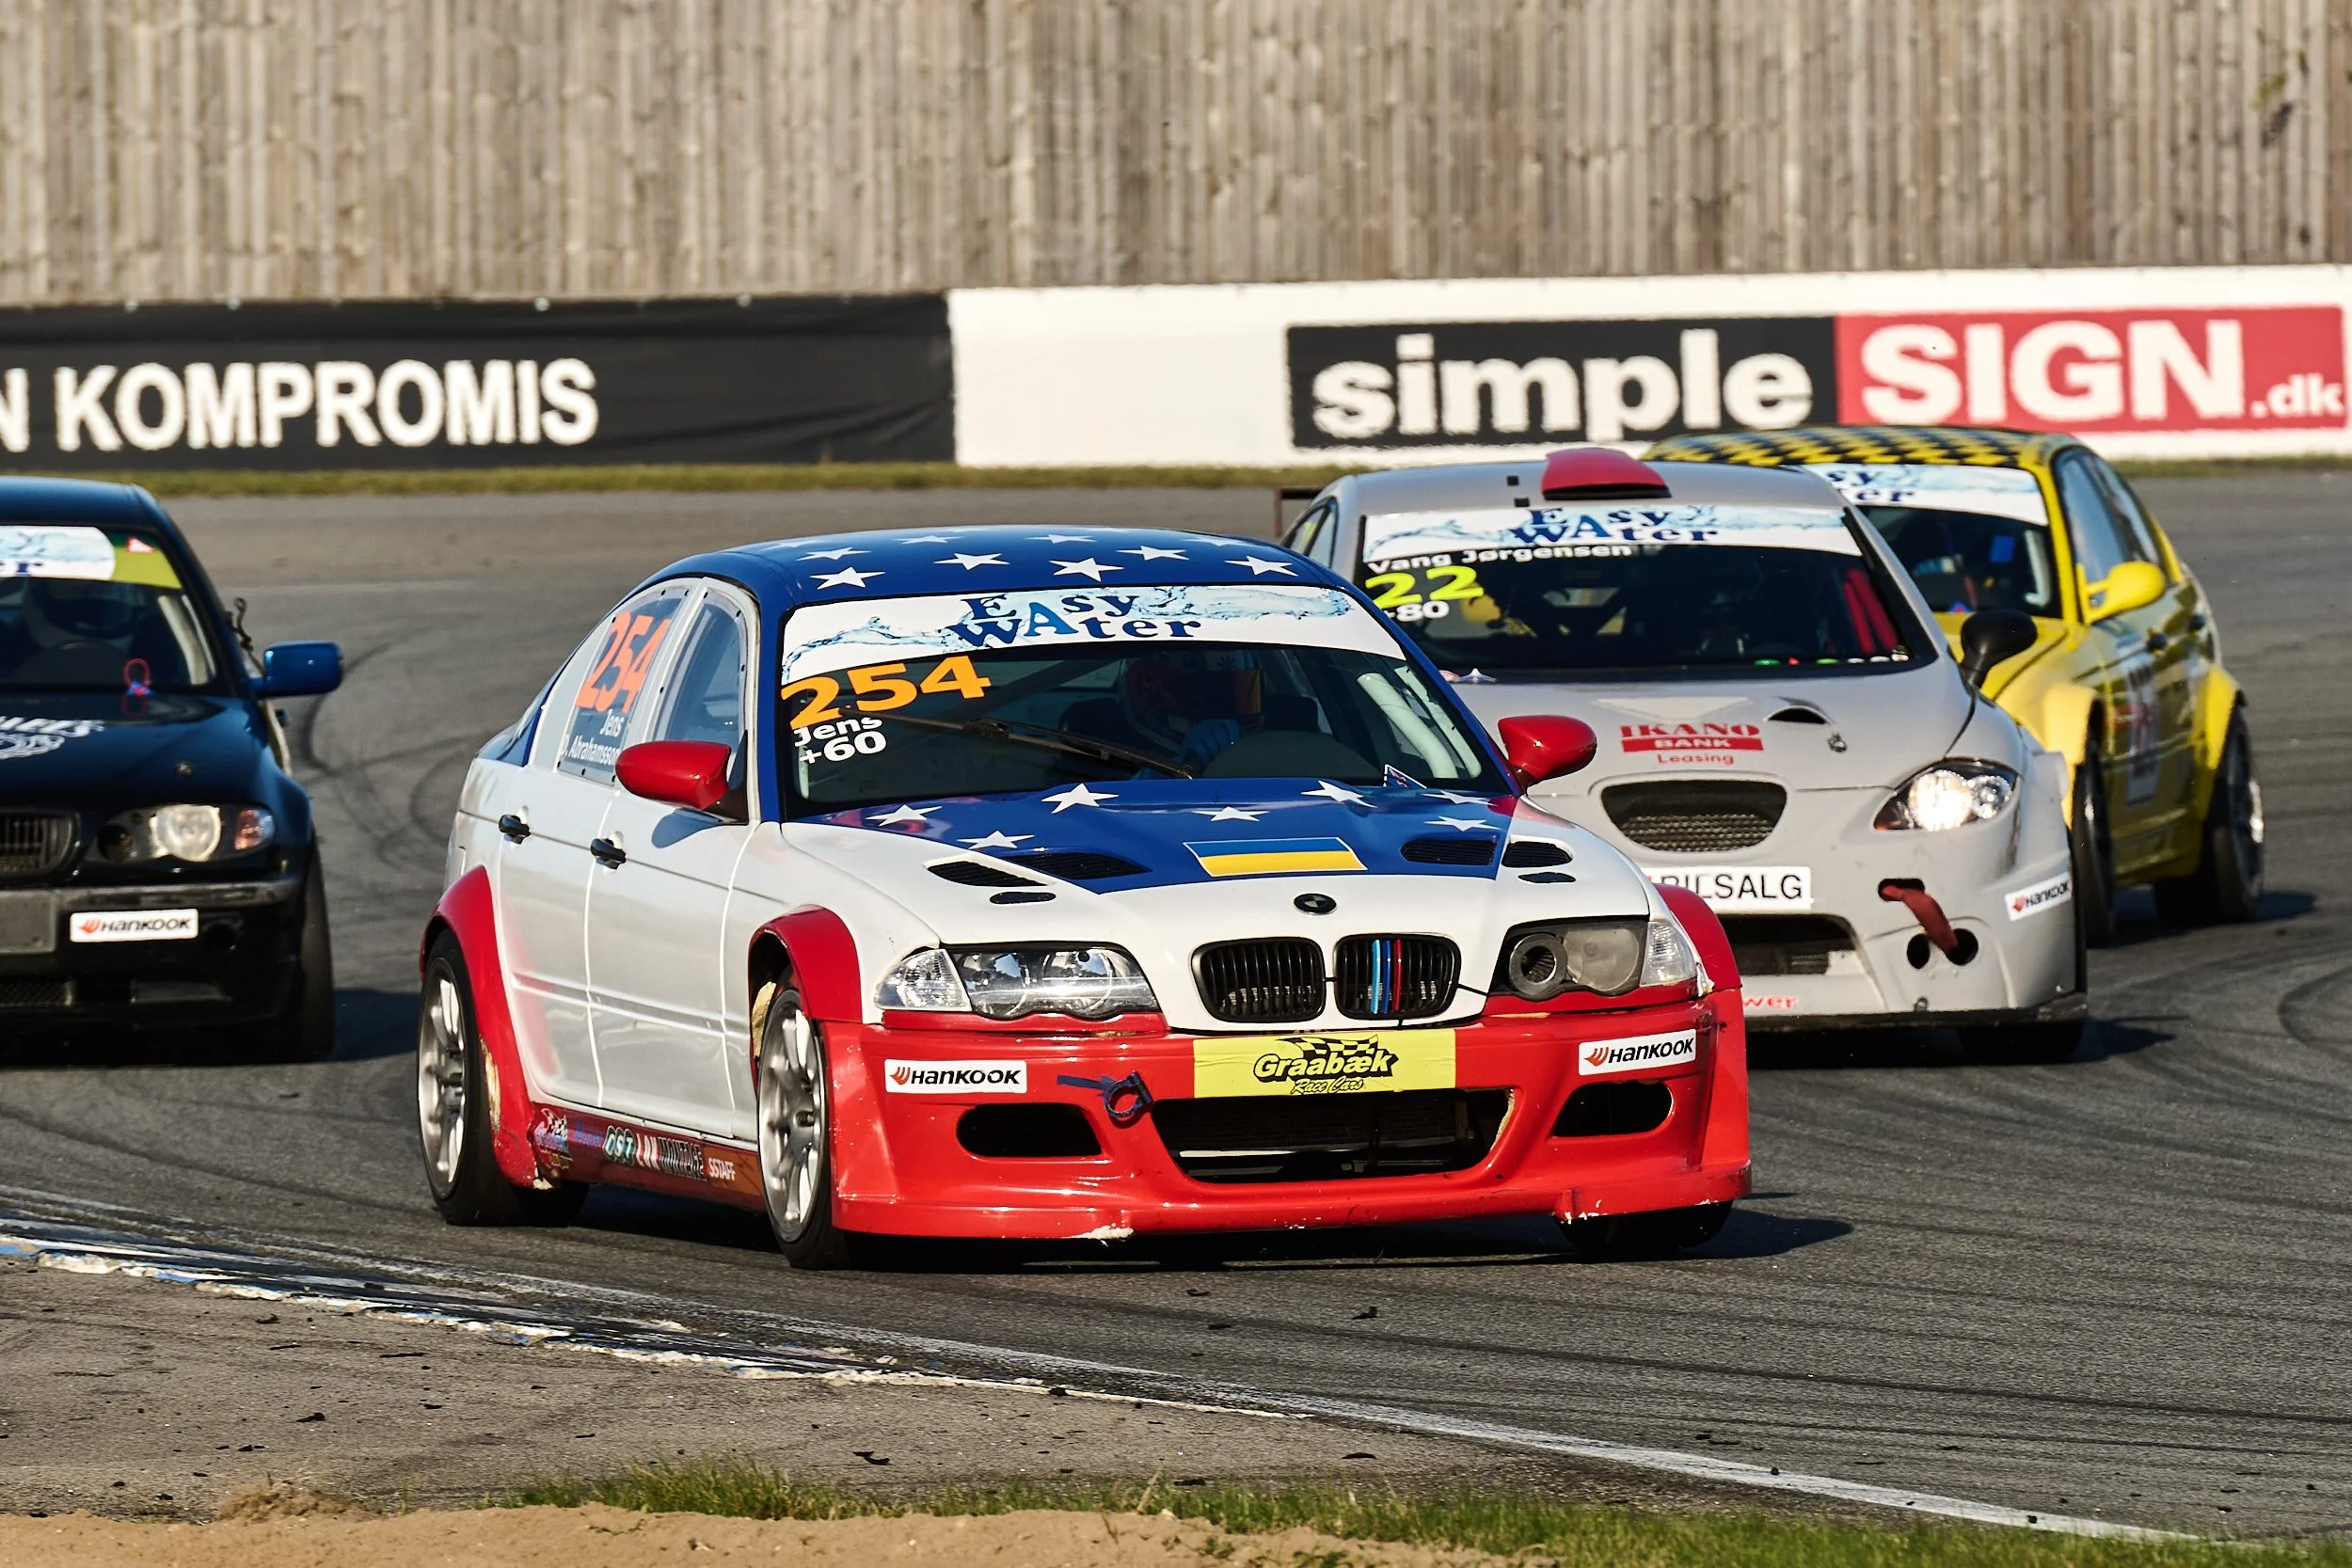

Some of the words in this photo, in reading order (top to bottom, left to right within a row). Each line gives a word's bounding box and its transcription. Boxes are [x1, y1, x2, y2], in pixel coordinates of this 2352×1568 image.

[1312, 328, 1813, 441] simple
[54, 357, 598, 451] KOMPROMIS
[1368, 553, 1452, 574] Vang
[1461, 545, 1632, 564] Jørgensen
[1365, 565, 1485, 610] 22
[576, 610, 673, 714] 254
[780, 656, 993, 730] 254
[599, 708, 625, 737] Jens
[793, 716, 883, 748] Jens
[1619, 722, 1760, 737] IKANO
[799, 730, 887, 765] +60
[1654, 738, 1732, 749] BANK
[1657, 753, 1735, 765] Leasing
[1254, 1049, 1395, 1081] Graabæk
[1290, 1078, 1327, 1095] Race
[1327, 1075, 1364, 1095] Cars
